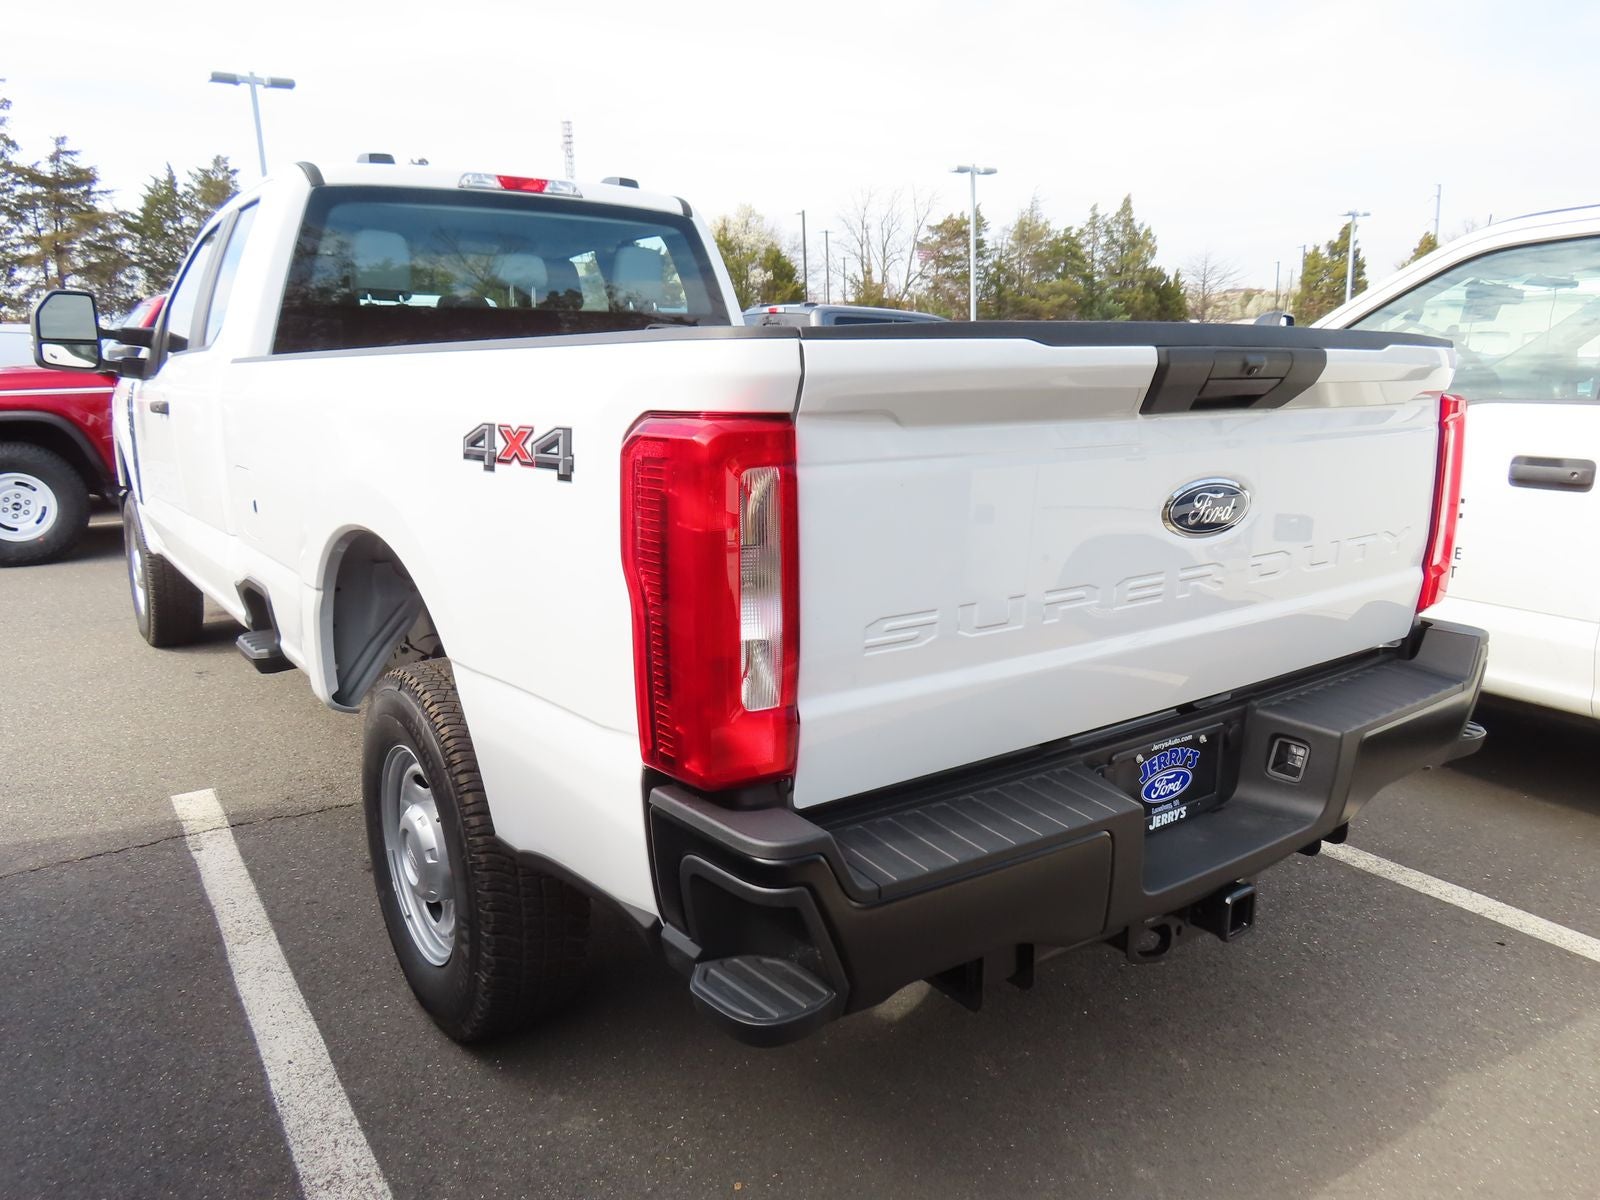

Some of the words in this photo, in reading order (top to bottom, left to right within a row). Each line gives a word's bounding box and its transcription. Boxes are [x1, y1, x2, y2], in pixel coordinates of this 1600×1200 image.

[1187, 492, 1236, 526] Ford
[863, 560, 1225, 657] SUPER
[1248, 525, 1412, 584] DUTY
[1151, 734, 1193, 752] JerrysAuto.com
[1150, 773, 1183, 799] Ford
